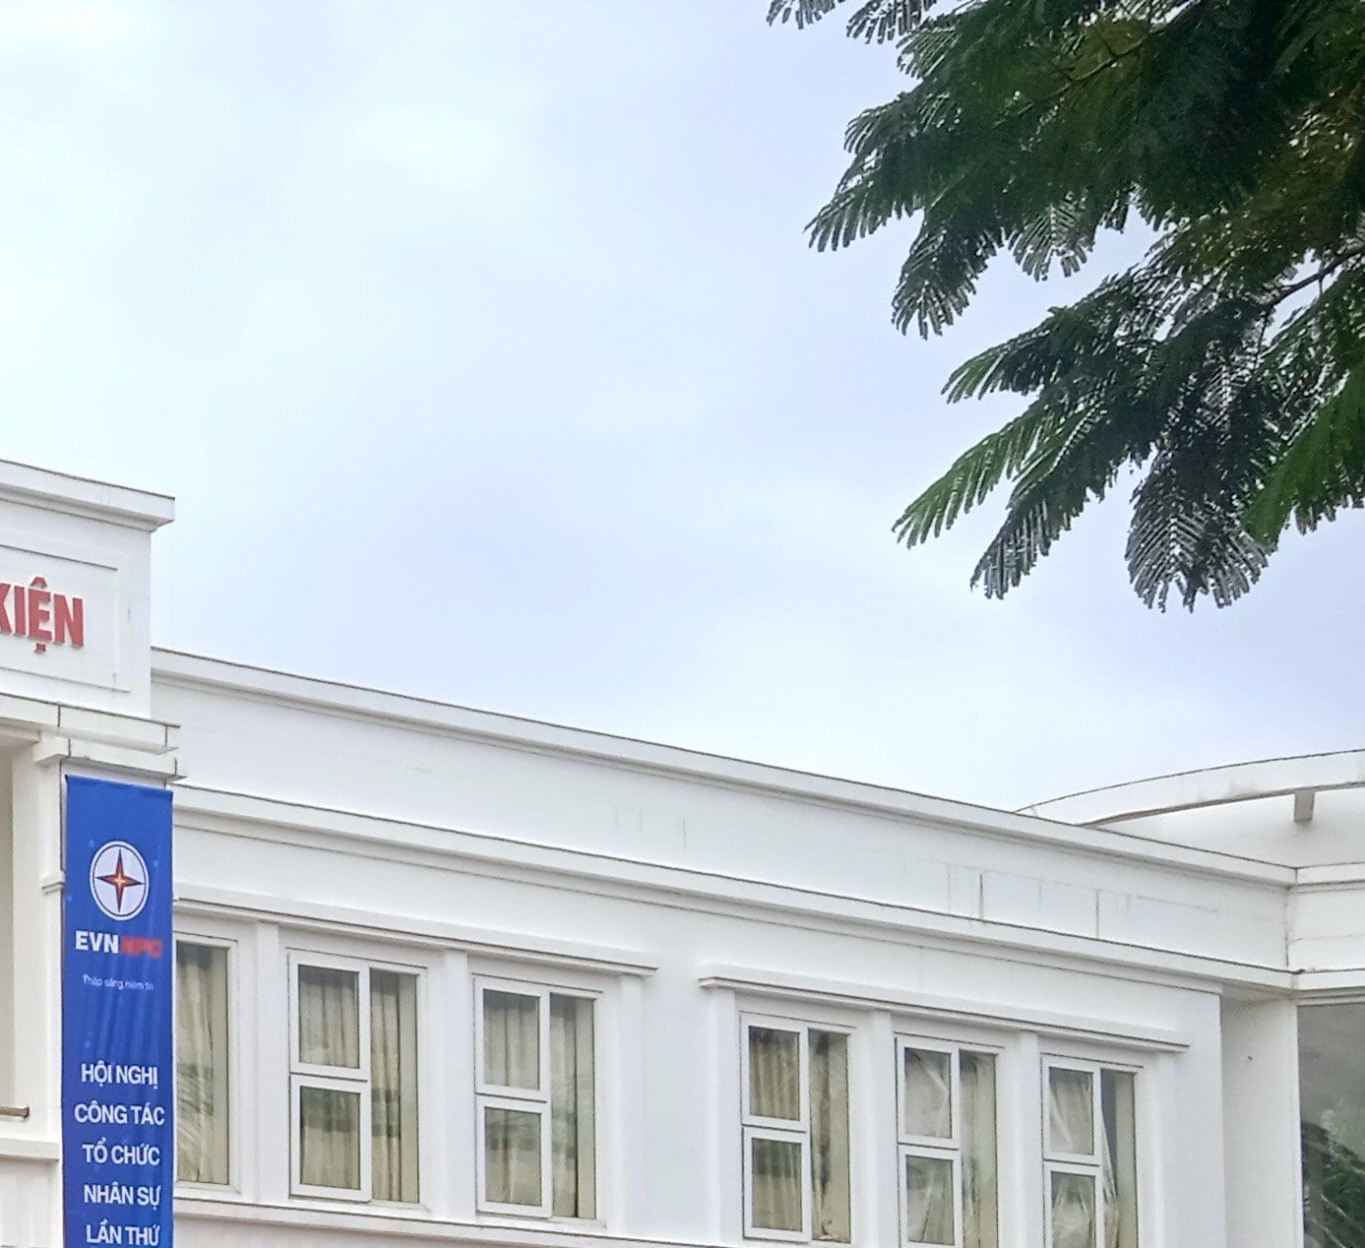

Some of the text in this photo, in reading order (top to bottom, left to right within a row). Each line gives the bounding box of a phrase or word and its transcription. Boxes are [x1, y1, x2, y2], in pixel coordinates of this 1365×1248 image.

[82, 1060, 157, 1089] HỘI NGHỊ
[75, 1100, 164, 1125] CÔNG TÁC
[82, 1137, 159, 1165] TỔ CHỨC
[84, 1182, 161, 1210] NHÂN SỰ
[87, 1219, 160, 1246] LẦN THỨ
